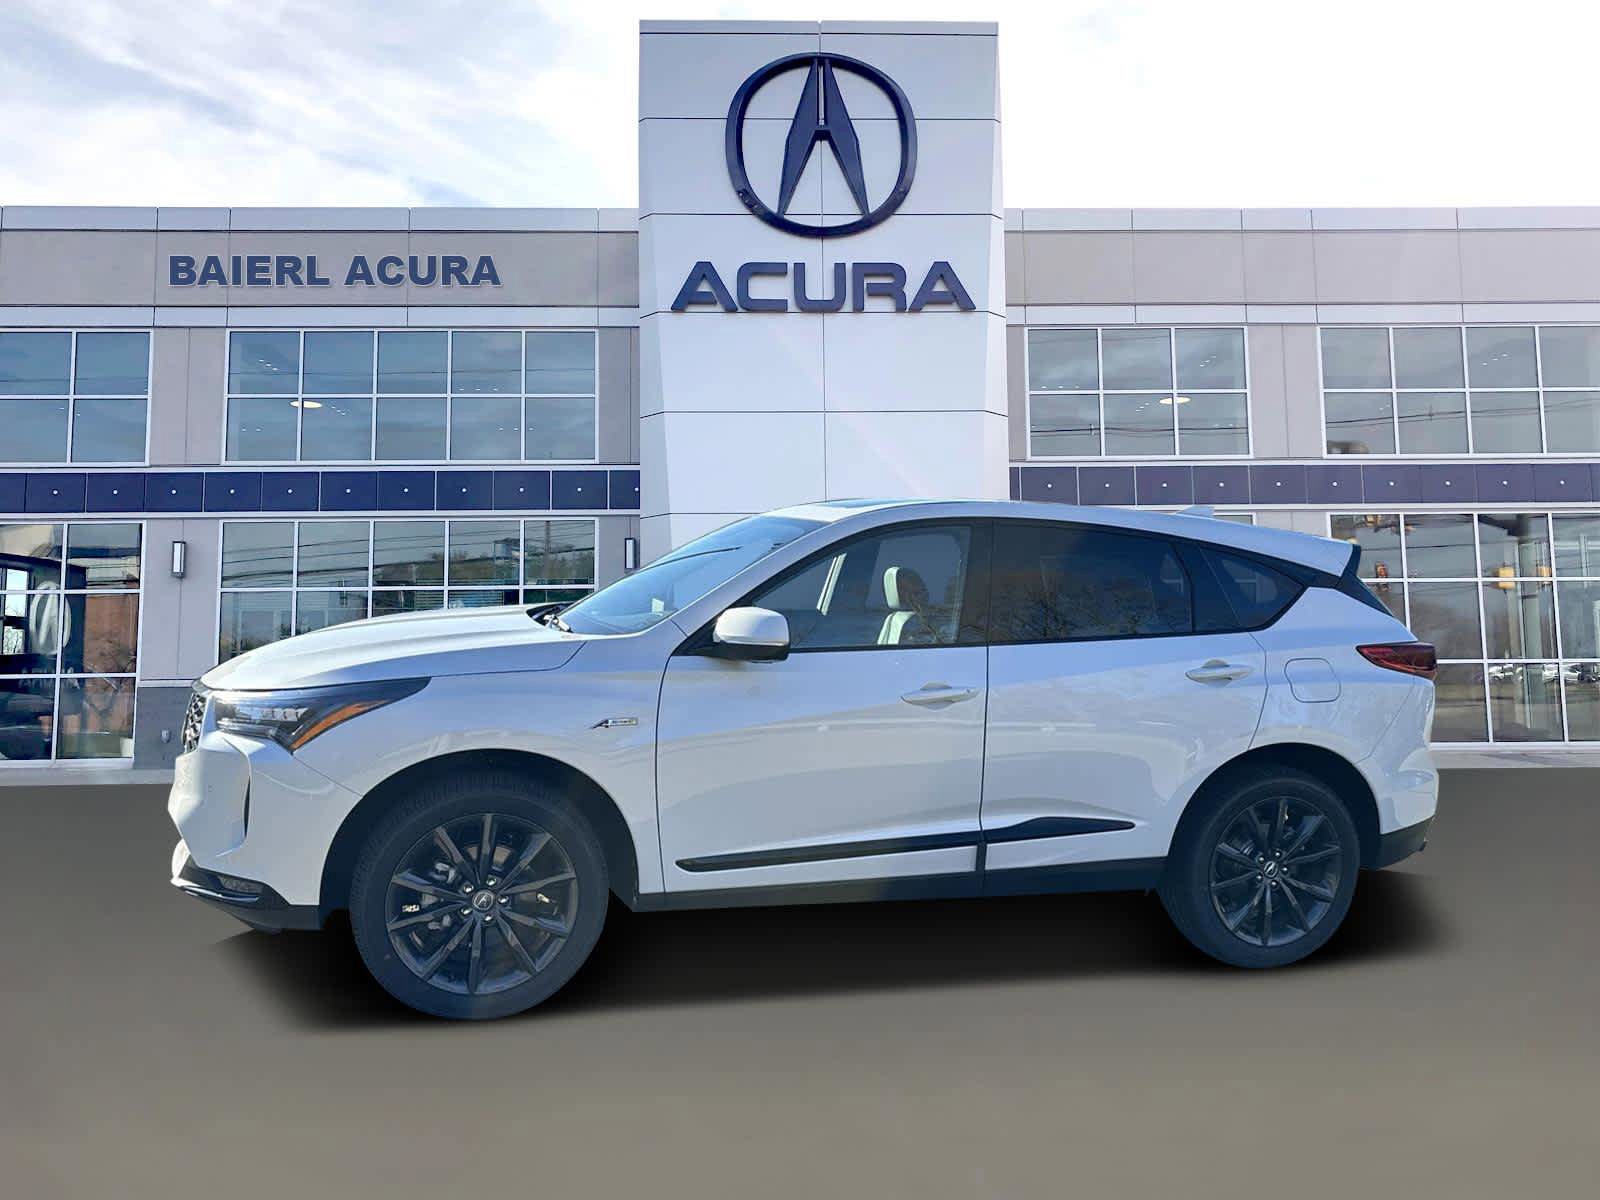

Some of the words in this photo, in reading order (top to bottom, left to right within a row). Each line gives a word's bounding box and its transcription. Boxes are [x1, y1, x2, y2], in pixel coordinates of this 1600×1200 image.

[168, 255, 330, 287] BAIERL
[343, 255, 502, 287] ACURA
[670, 261, 977, 313] ACURA
